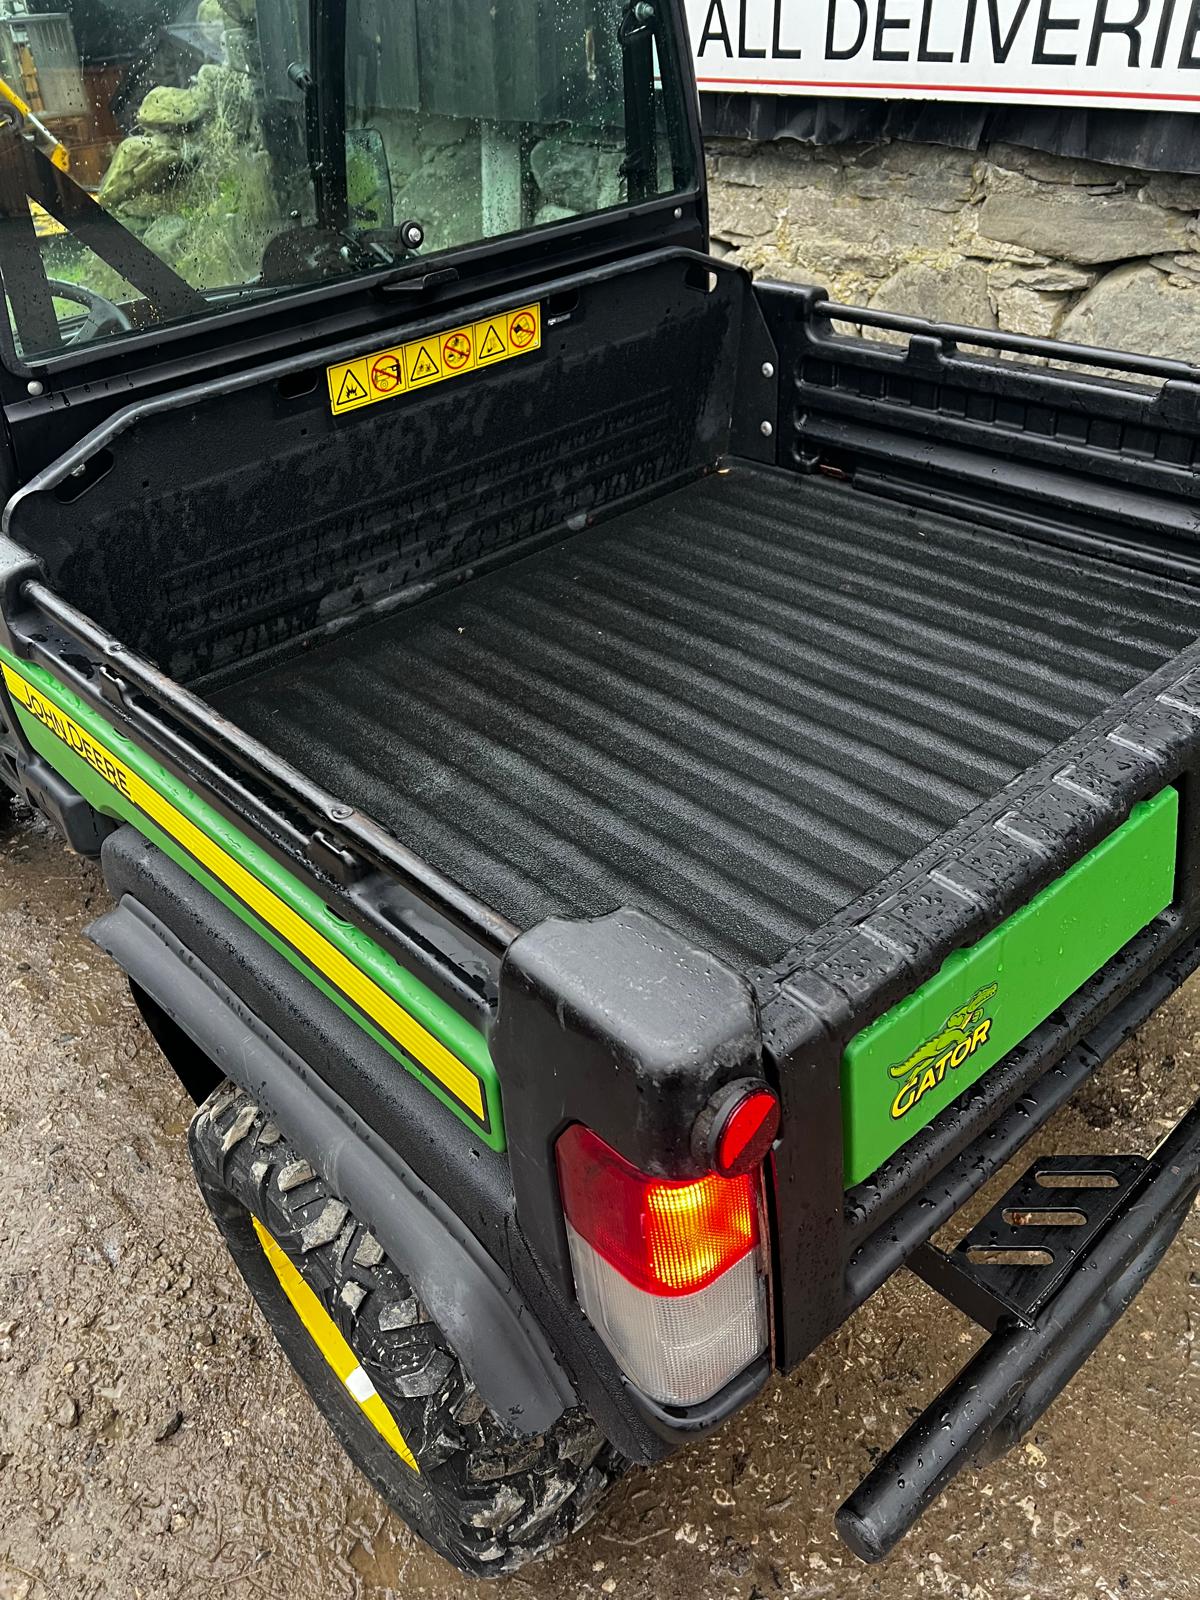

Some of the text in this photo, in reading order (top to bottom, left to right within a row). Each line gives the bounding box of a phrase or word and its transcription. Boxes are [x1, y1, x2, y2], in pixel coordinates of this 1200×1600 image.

[696, 0, 801, 59] ALL
[25, 685, 132, 797] JOHN DEERE
[891, 1018, 992, 1119] GATOR
